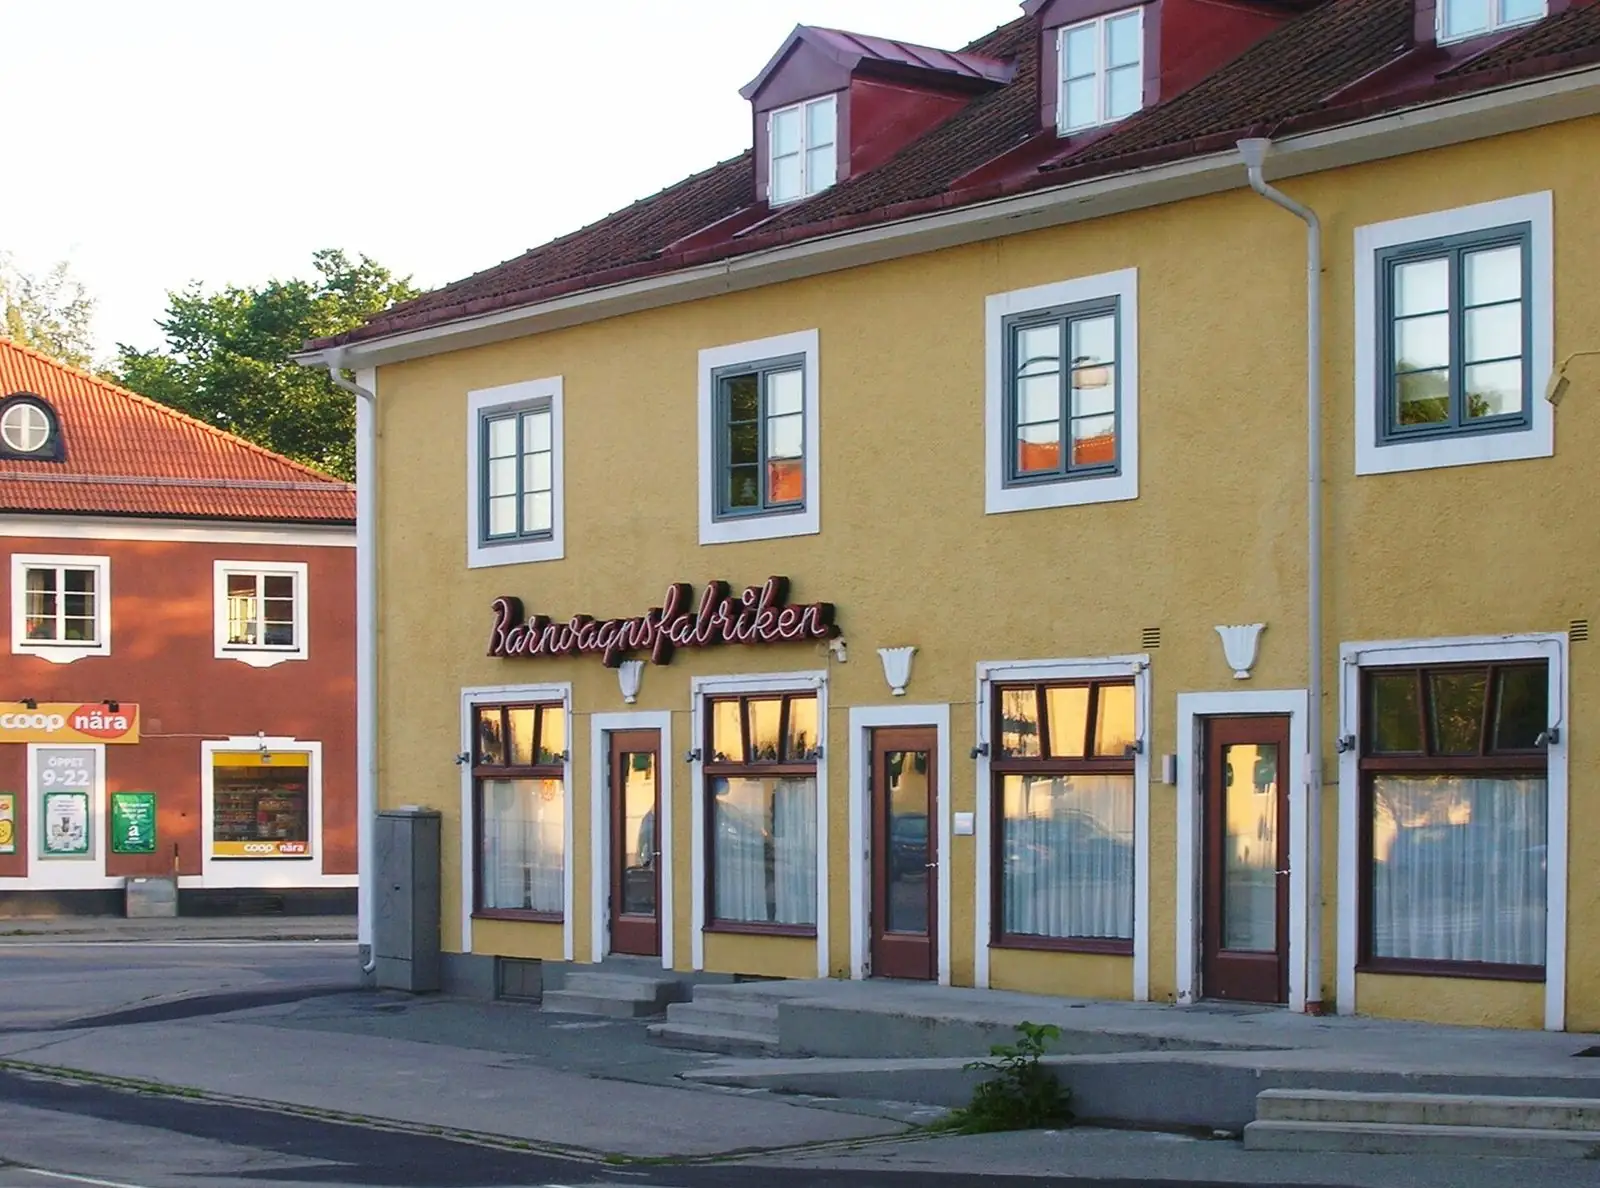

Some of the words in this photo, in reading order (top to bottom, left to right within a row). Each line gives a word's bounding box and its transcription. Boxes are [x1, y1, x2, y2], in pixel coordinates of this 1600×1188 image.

[488, 576, 835, 666] Barnvagnsfabriken
[0, 713, 65, 733] coop
[75, 711, 129, 730] nära
[42, 769, 90, 786] 9-22
[243, 843, 273, 853] coop
[279, 842, 303, 852] nära
